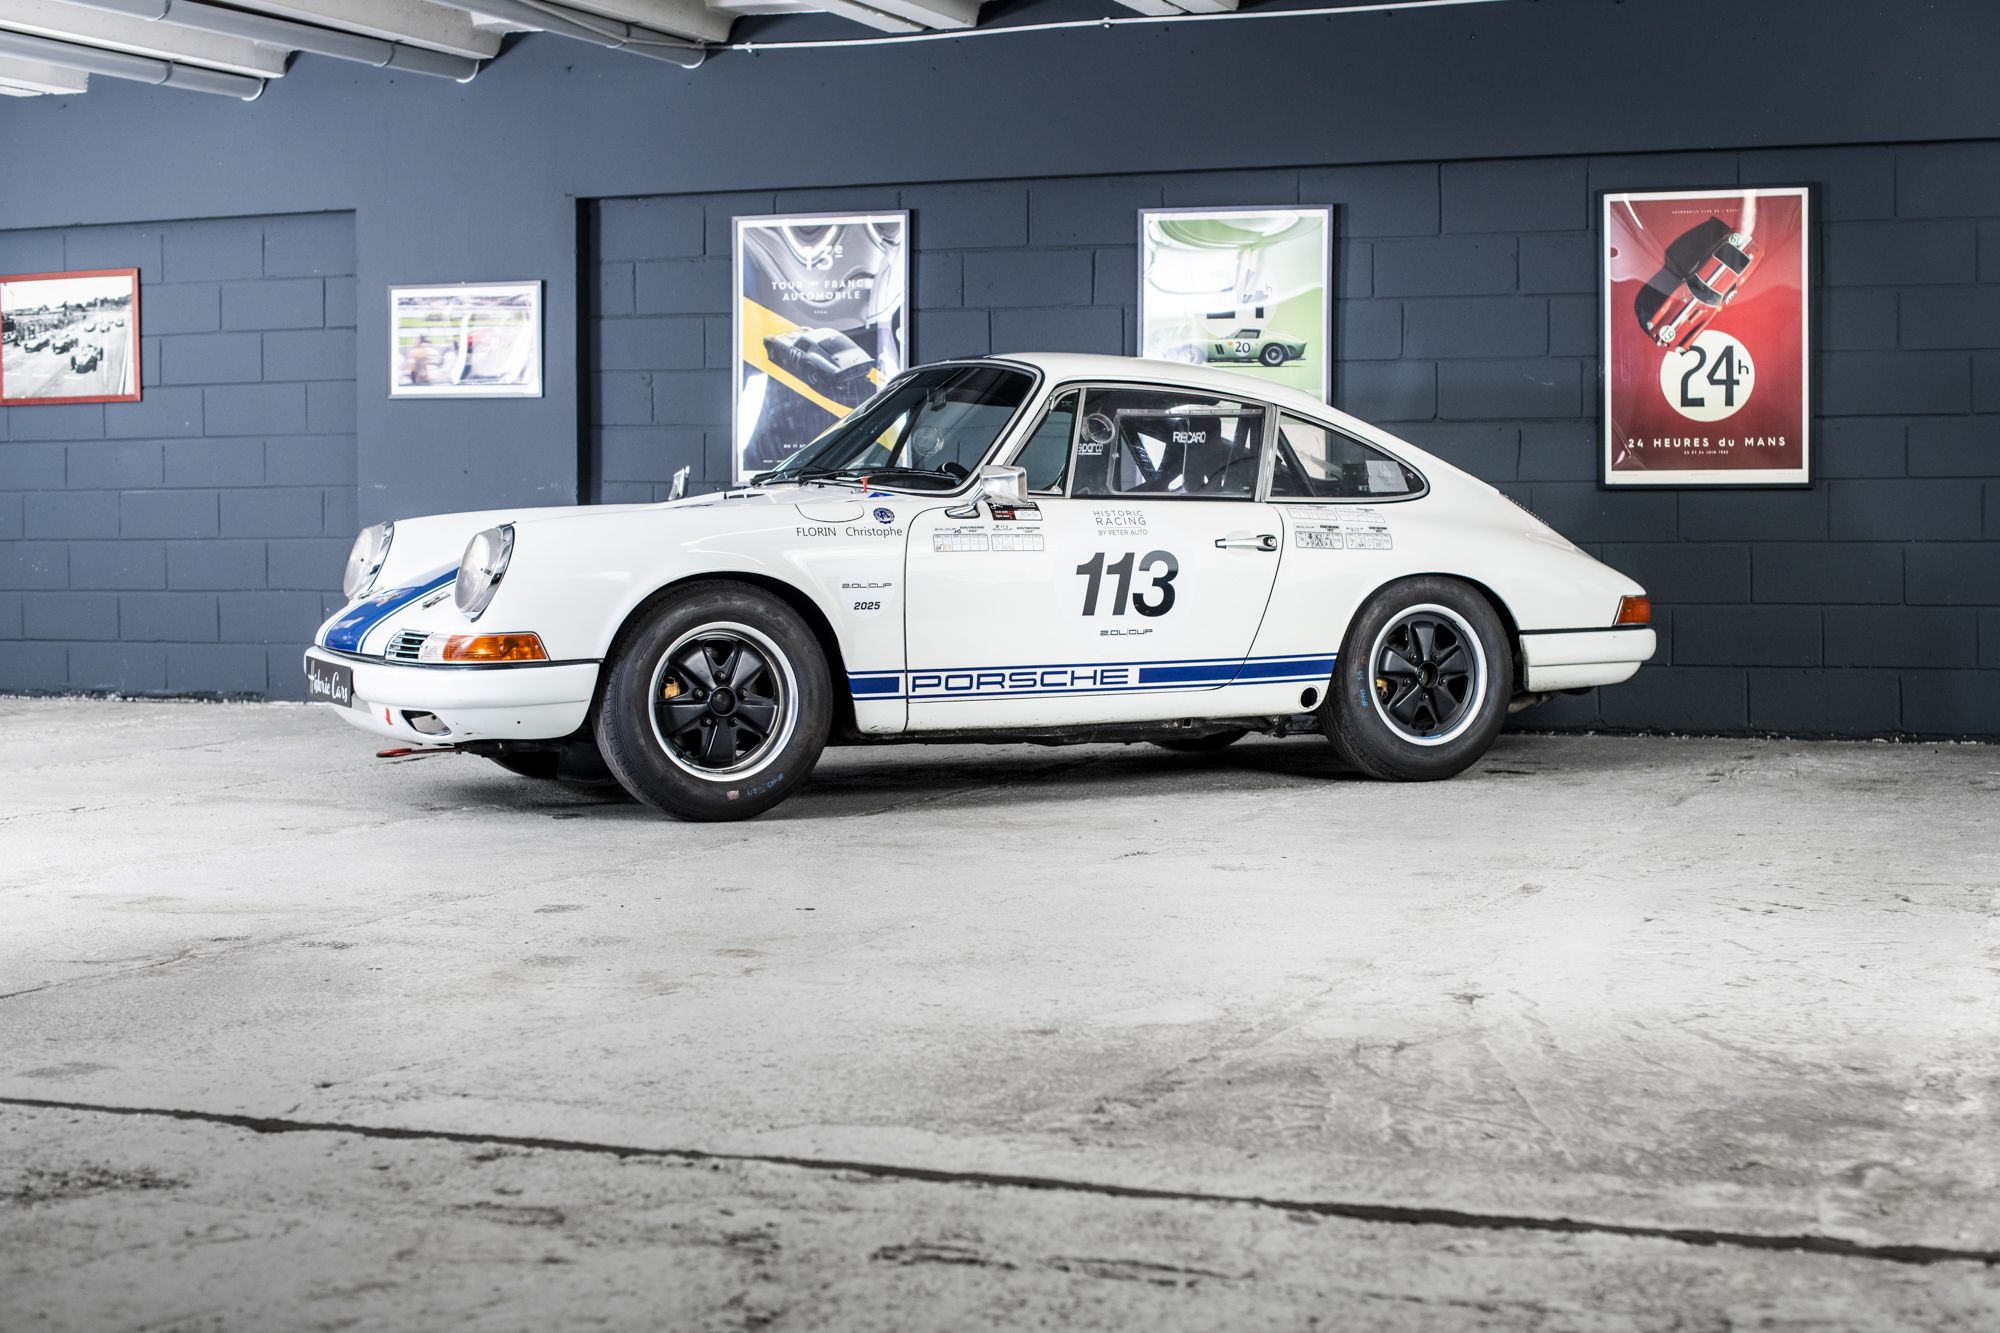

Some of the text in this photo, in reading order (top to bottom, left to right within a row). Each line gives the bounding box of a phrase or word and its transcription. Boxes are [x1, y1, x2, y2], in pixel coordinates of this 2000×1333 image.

[772, 279, 874, 290] TOUR FRANCE
[783, 290, 861, 301] AUTOMOBILE
[1235, 341, 1251, 353] 20
[1172, 431, 1206, 444] RECARO
[1628, 436, 1786, 448] 24 HEURES du MANS
[1095, 517, 1147, 526] RACING
[796, 526, 903, 538] FLORIN Christophe
[1076, 550, 1179, 617] 113
[853, 601, 881, 611] 2025
[912, 668, 1129, 693] PORSCHE
[331, 671, 348, 703] Cars
